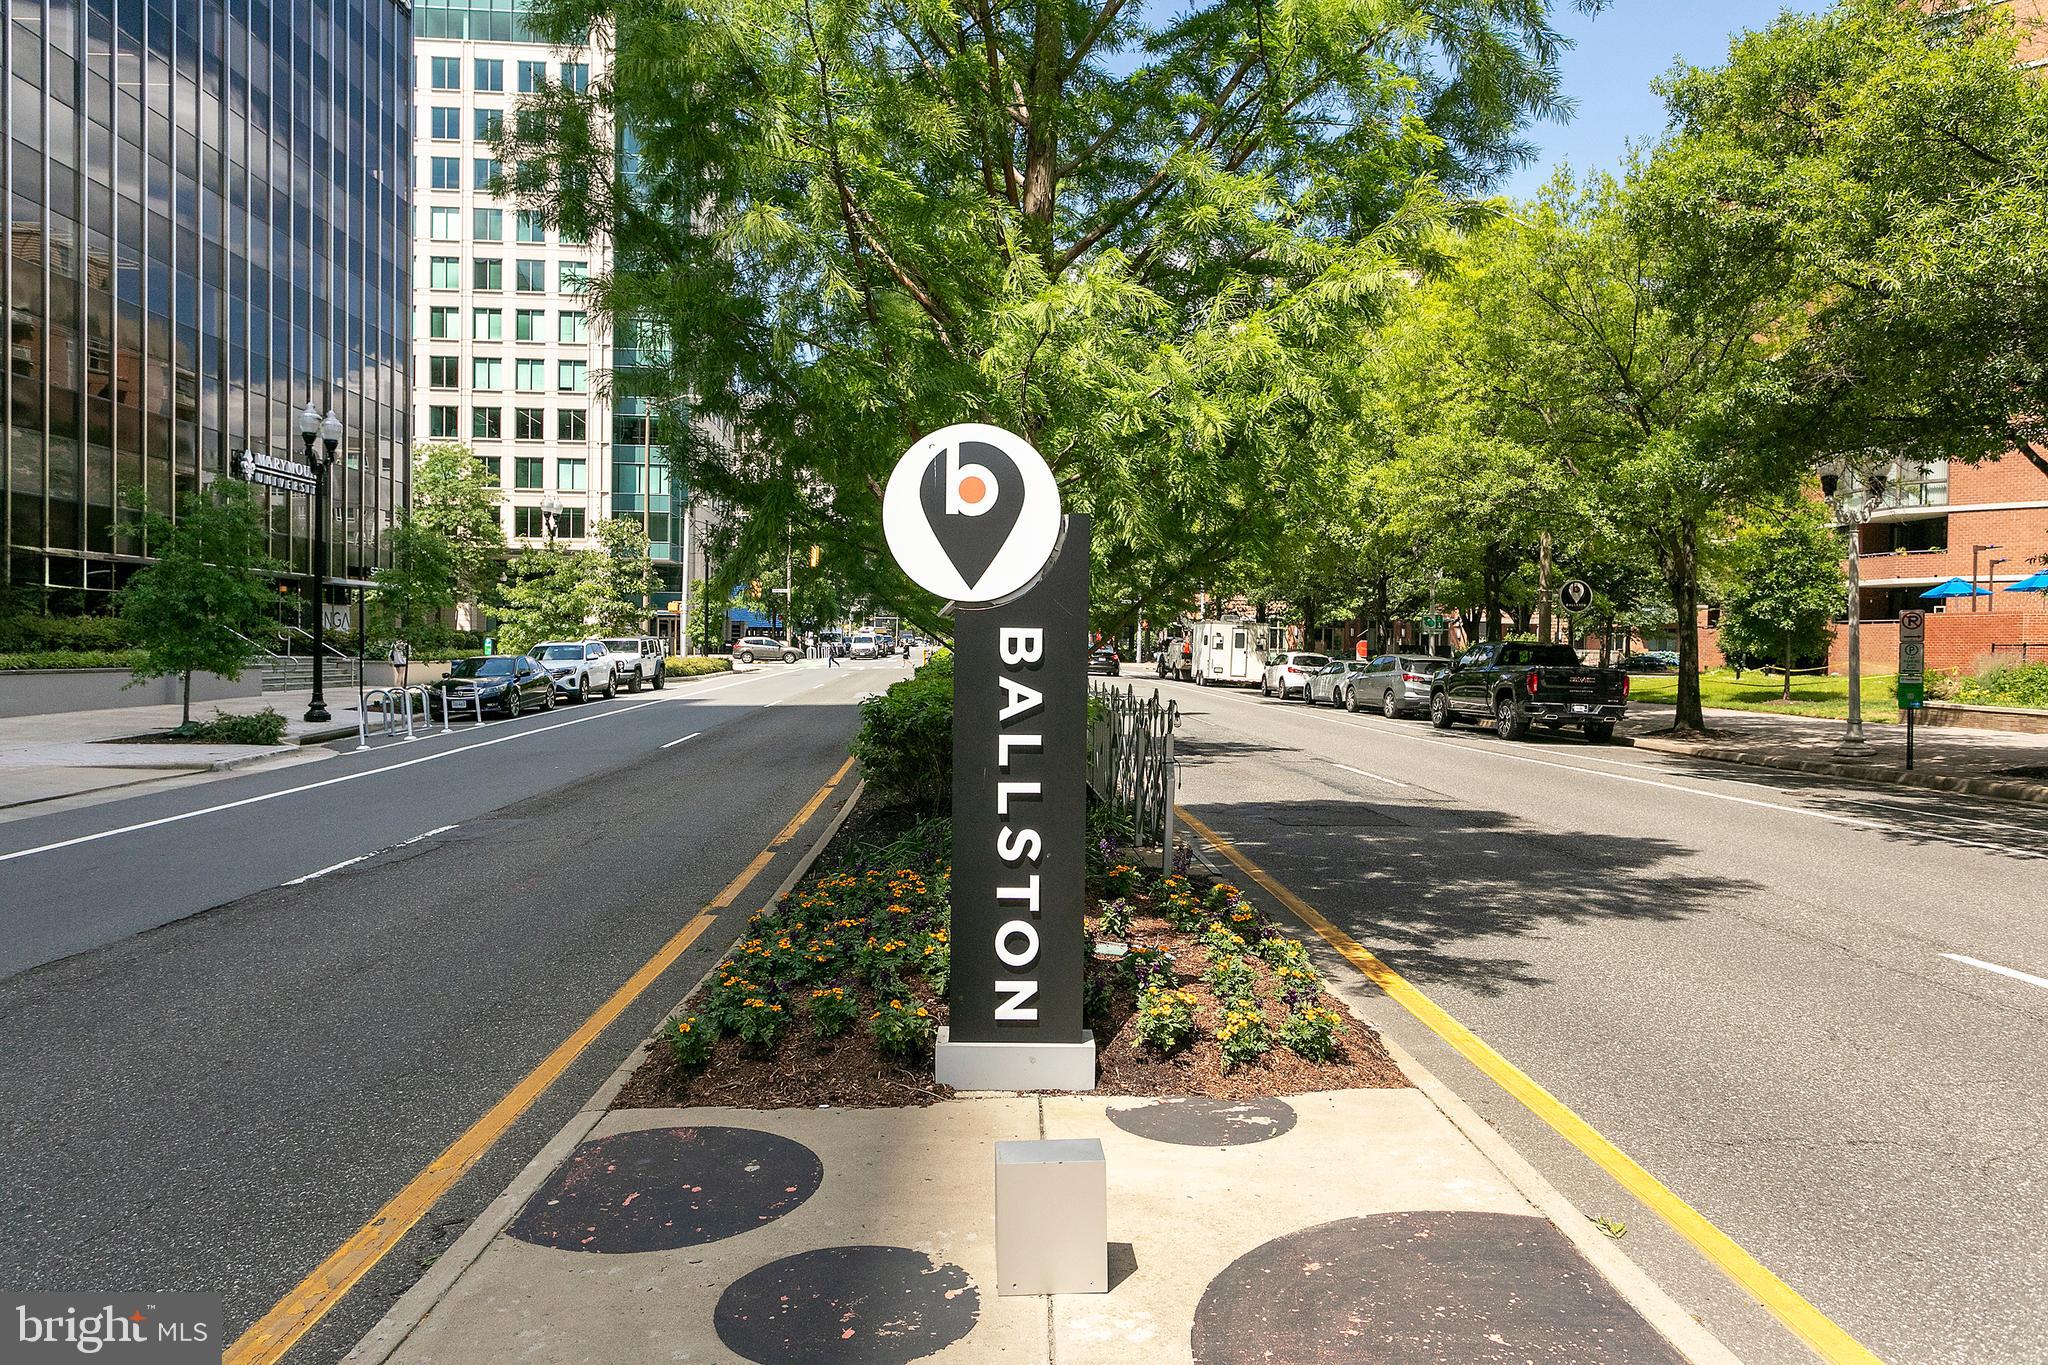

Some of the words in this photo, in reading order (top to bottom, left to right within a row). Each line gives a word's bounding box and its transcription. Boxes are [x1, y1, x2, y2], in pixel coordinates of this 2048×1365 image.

[254, 452, 317, 479] MARYMOU
[254, 472, 317, 495] UNIVERSIT
[994, 627, 1044, 1021] BALLSTON
